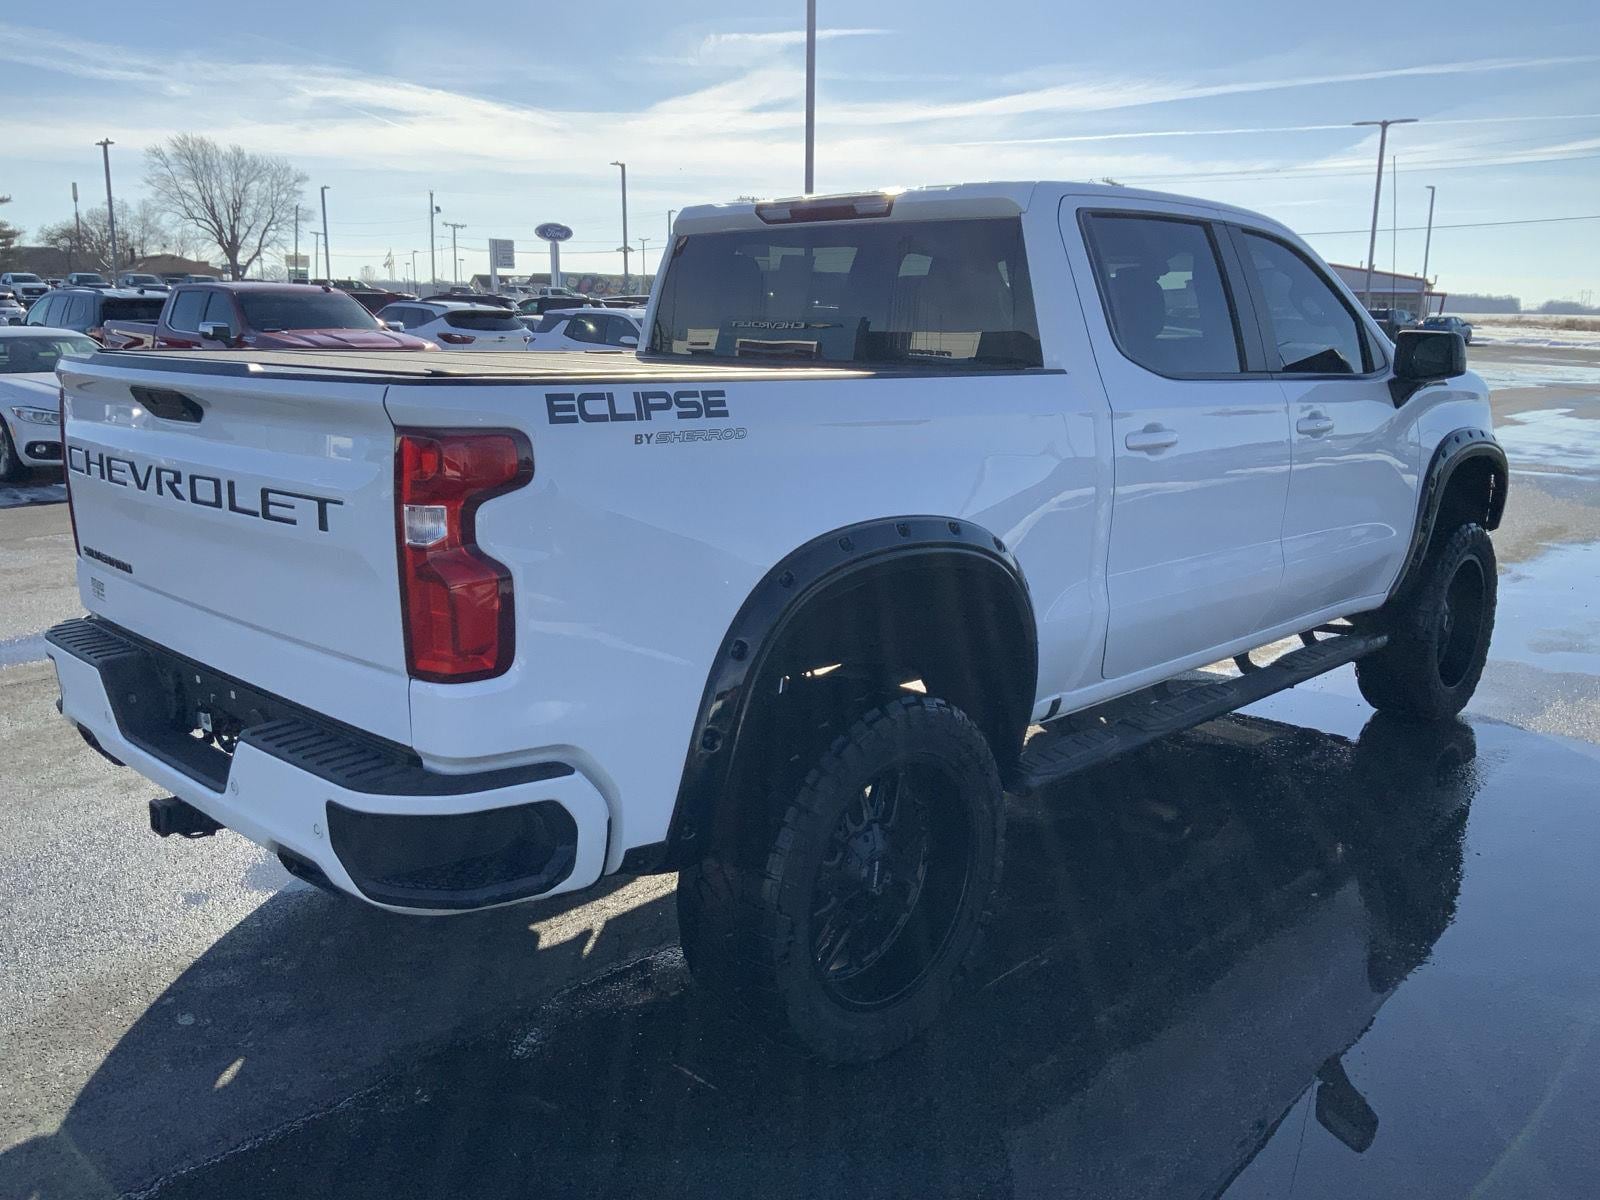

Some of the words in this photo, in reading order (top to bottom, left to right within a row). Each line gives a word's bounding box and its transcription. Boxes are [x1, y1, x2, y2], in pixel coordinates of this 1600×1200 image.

[545, 390, 729, 425] ECLIPSE
[634, 433, 654, 445] BY
[655, 428, 748, 444] SHERROD
[69, 445, 344, 532] CHEVROLET
